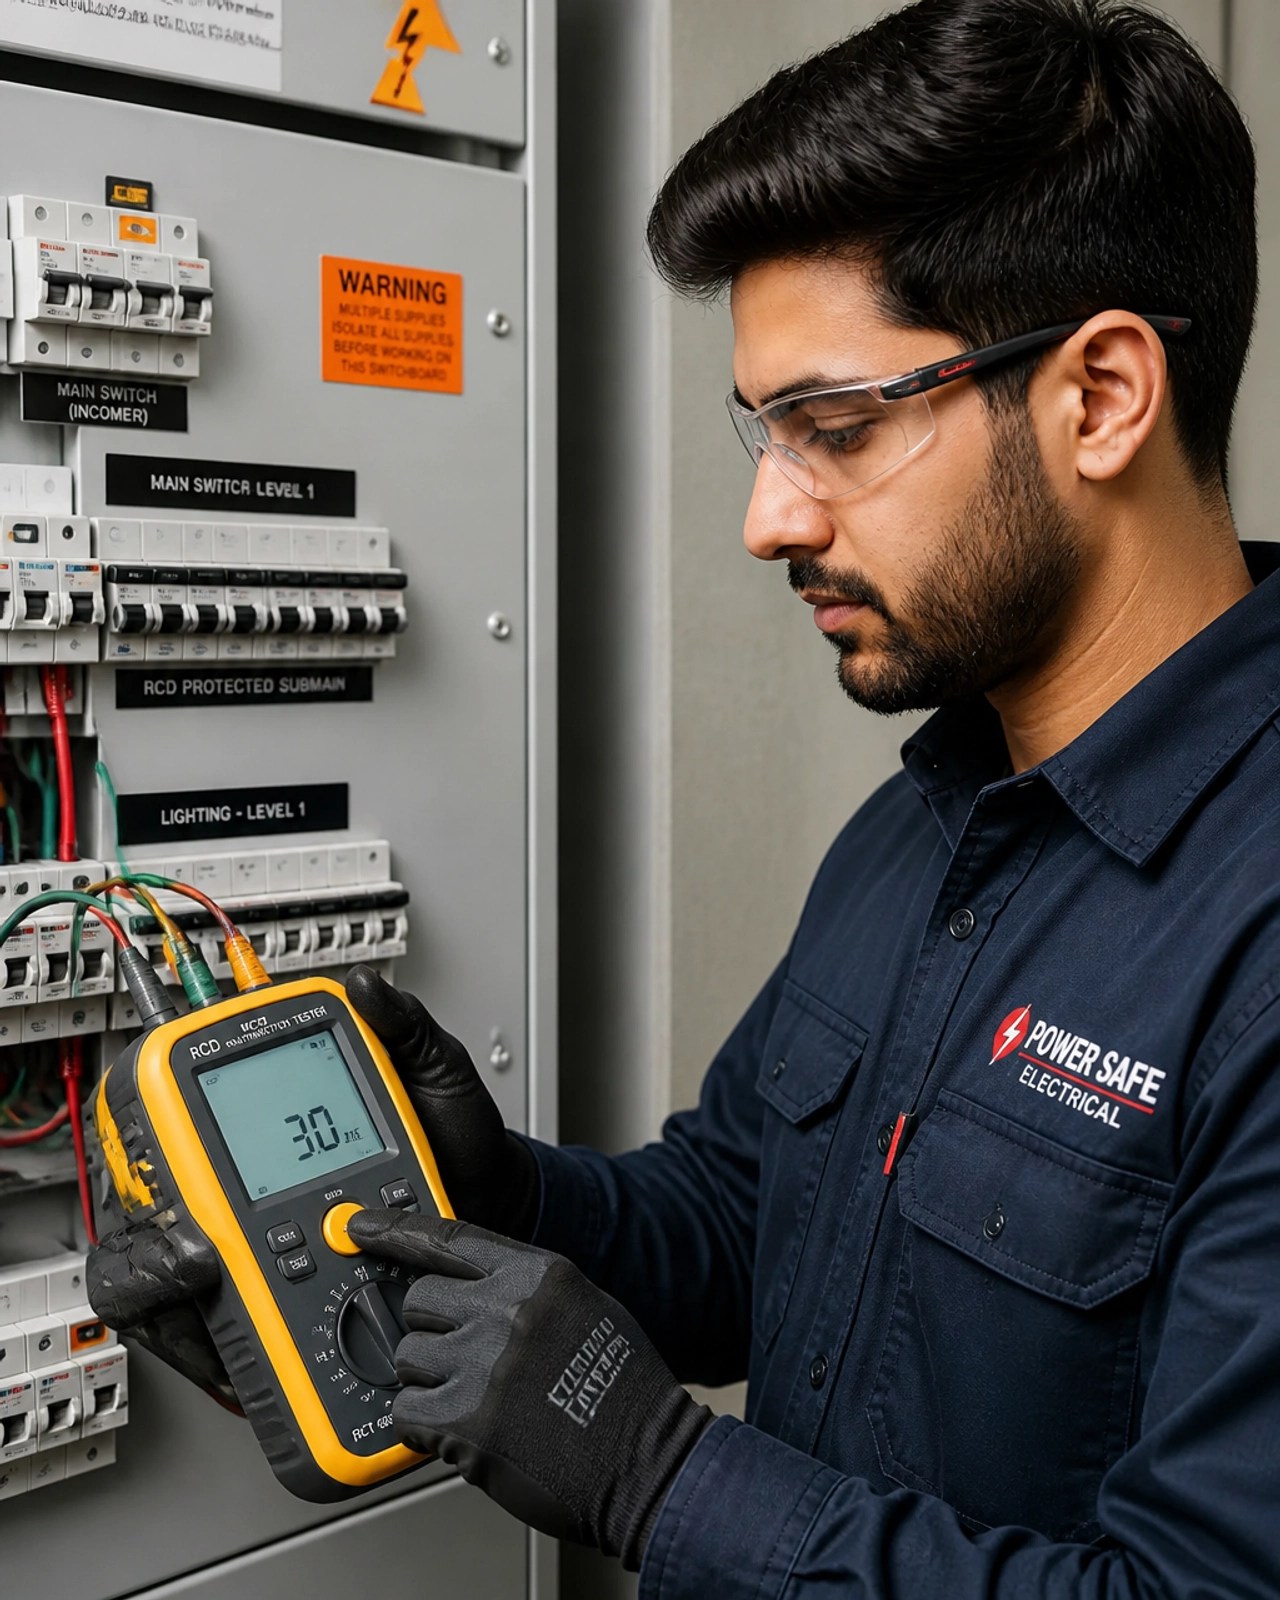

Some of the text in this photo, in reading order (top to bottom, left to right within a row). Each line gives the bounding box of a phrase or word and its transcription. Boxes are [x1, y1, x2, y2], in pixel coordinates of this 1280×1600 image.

[338, 269, 447, 305] WARNING
[339, 303, 446, 328] MULTIPLE SUPPLIES
[332, 321, 377, 338] ISOLATE
[381, 327, 400, 341] ALL
[334, 339, 452, 364] BEFORE WORKING ON
[341, 358, 366, 375] THIS
[57, 382, 157, 404] MAIN SWITCH
[68, 402, 149, 427] (INCOMER)
[151, 474, 189, 492] MAIN
[306, 483, 314, 500] 1
[144, 676, 346, 696] RCD PROTECTED SUBMAIN
[161, 804, 232, 826] LIGHTING
[247, 801, 295, 820] LEVEL
[298, 800, 306, 817] 1
[189, 1038, 222, 1060] RCD
[1024, 1019, 1167, 1105] POWER SAFE
[1018, 1063, 1121, 1129] ELECTRICAL
